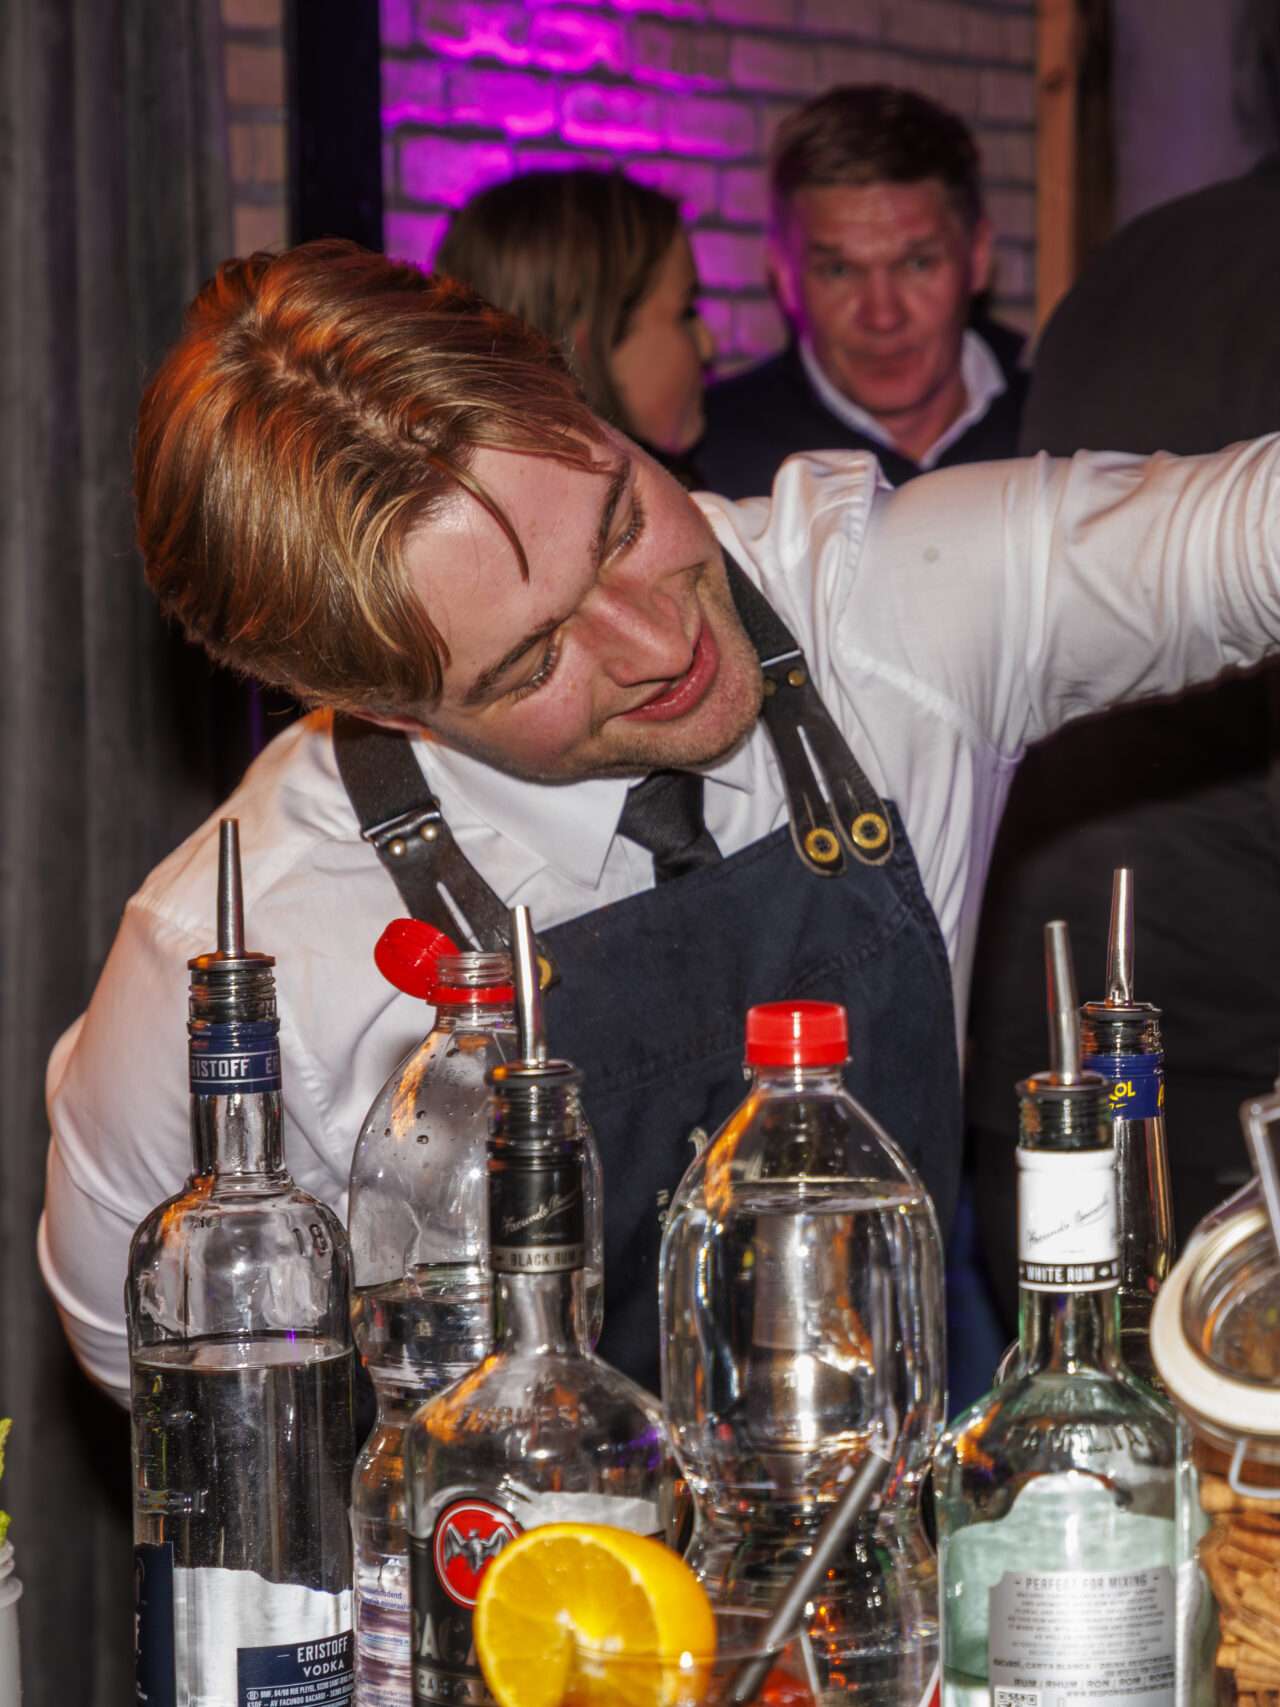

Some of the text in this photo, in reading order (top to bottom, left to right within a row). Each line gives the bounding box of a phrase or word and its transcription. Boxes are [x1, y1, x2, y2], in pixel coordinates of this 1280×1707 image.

[510, 1251, 551, 1266] BLACK
[1026, 1265, 1095, 1282] WHITE RUM
[1109, 1573, 1148, 1587] MIXING
[297, 1636, 348, 1663] ERISTOFF
[303, 1659, 345, 1678] VODKA
